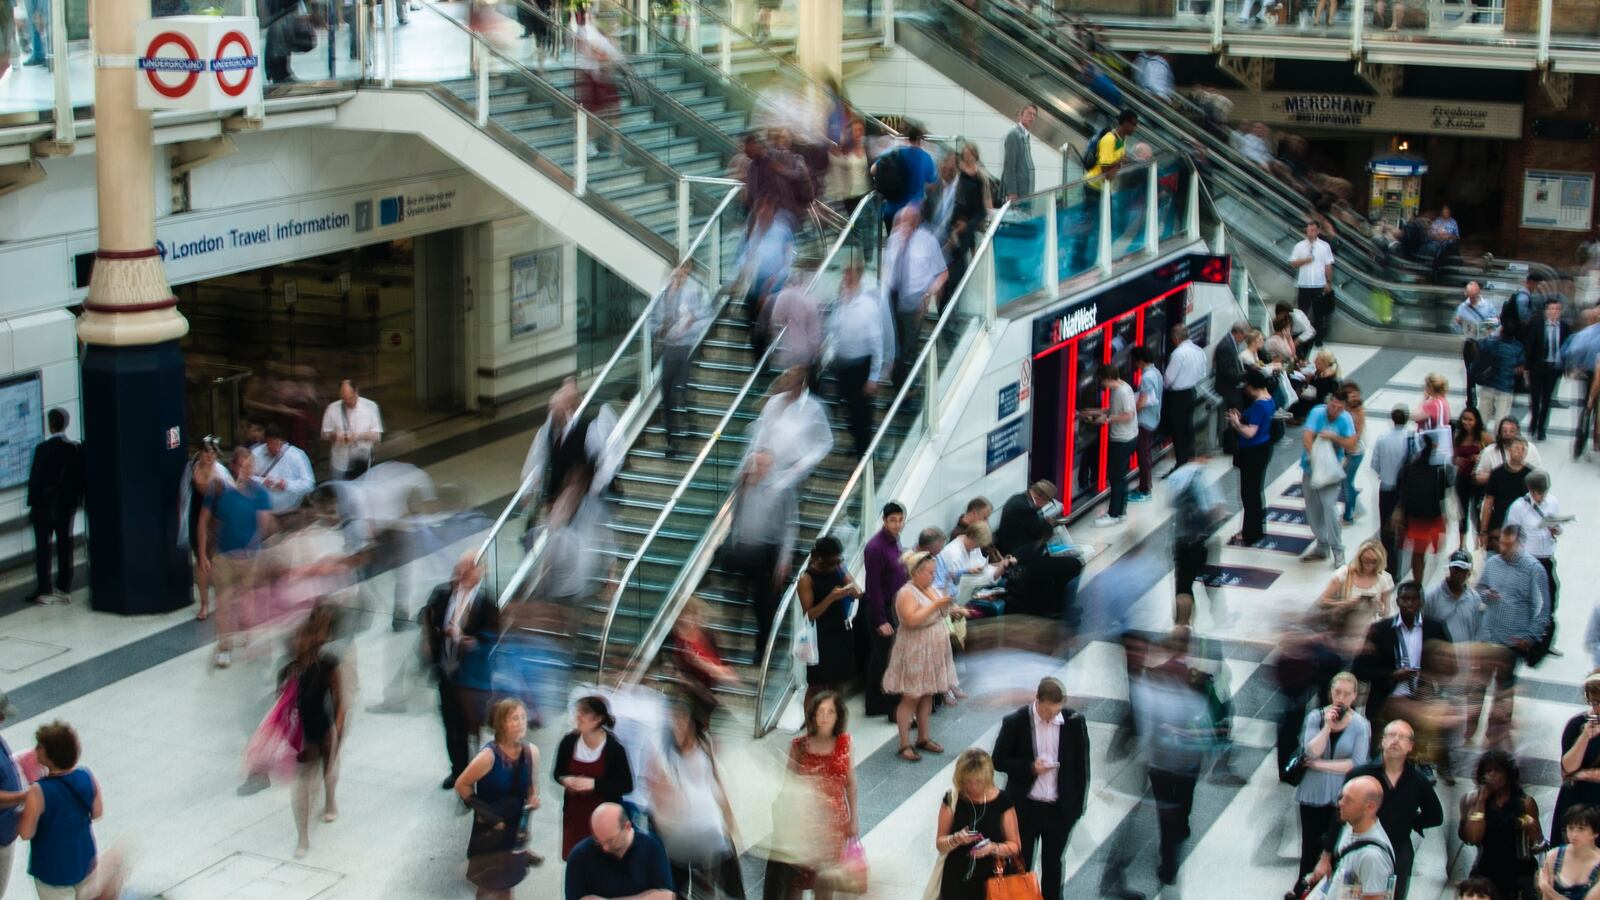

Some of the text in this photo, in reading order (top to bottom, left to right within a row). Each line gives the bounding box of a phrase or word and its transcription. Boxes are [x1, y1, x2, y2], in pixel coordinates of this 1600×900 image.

[142, 59, 203, 69] UNDERGROUND
[212, 57, 256, 69] UNDERGROUND
[1285, 95, 1376, 115] MERCHANT
[1431, 105, 1488, 118] Freehouse
[1296, 113, 1362, 124] BISHOPSGATE
[1446, 116, 1486, 128] Kitchen
[172, 212, 350, 260] London Travel Information
[1063, 302, 1097, 341] NatWest
